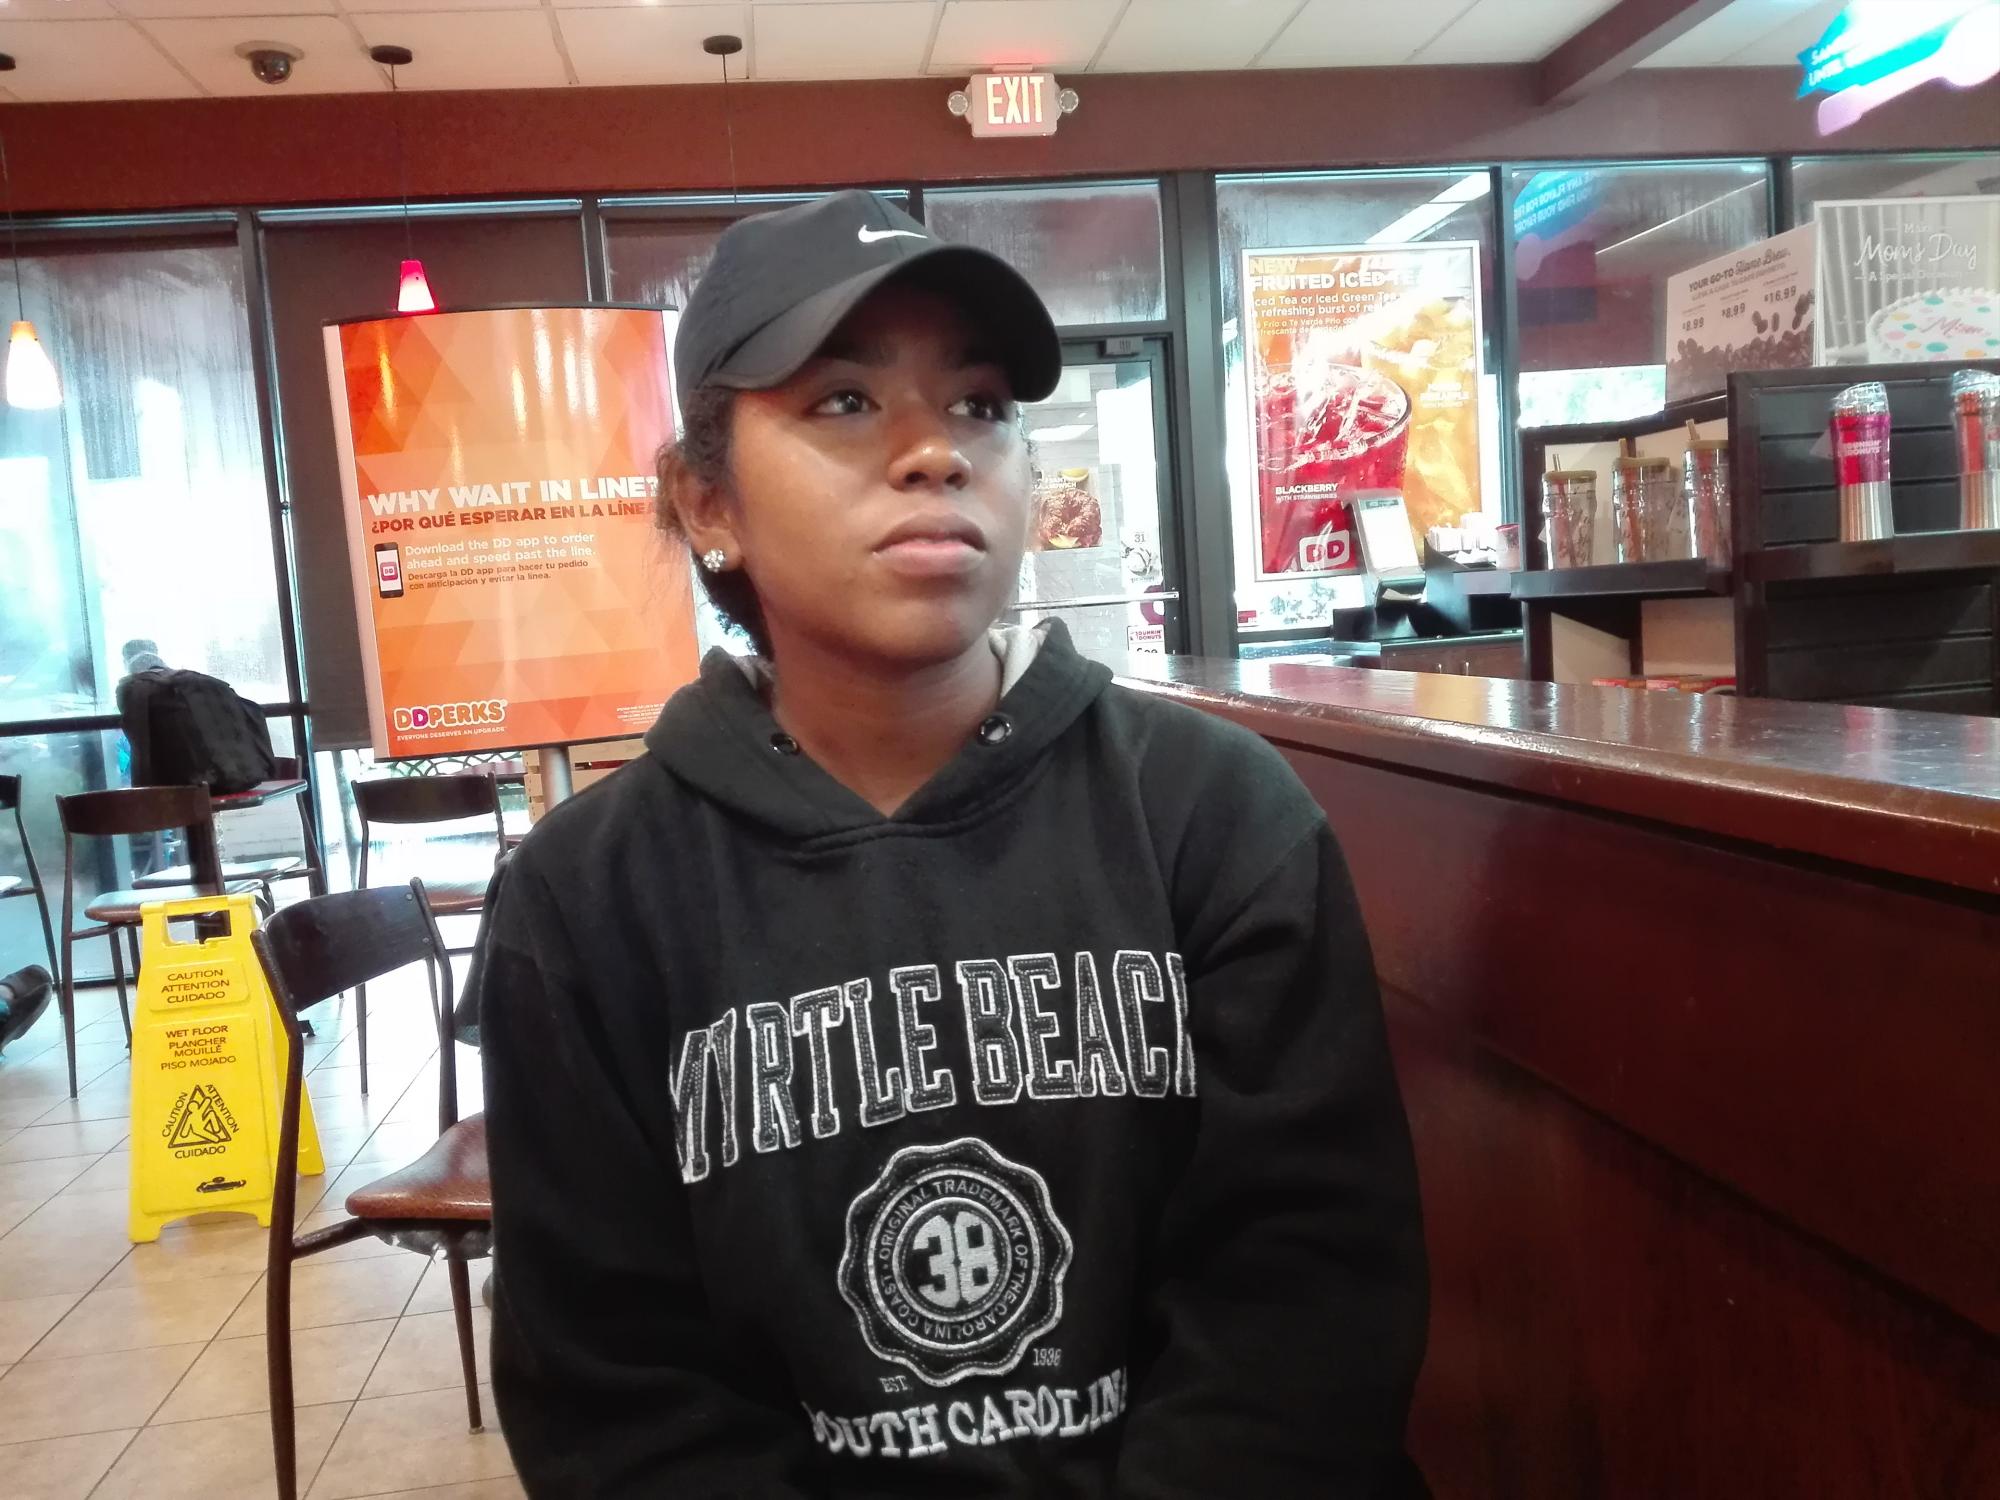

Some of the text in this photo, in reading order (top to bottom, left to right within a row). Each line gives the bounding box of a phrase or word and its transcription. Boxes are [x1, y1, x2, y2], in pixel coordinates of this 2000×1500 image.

[986, 76, 1045, 124] EXIT
[1250, 273, 1336, 292] FRUITED
[1340, 271, 1385, 289] ICED
[1689, 277, 1709, 293] YOUR
[1710, 267, 1734, 285] GO-TO
[1278, 295, 1298, 305] Tea
[1301, 295, 1313, 304] or
[1316, 293, 1339, 303] Iced
[1342, 292, 1375, 303] Green
[1261, 305, 1316, 318] refreshing
[1318, 303, 1346, 314] burst
[1349, 302, 1361, 312] of
[368, 476, 659, 517] WHY WAIT IN LINE?
[1275, 483, 1338, 495] BLACKBERRY
[371, 518, 415, 534] ¿POR
[419, 512, 457, 529] QUÉ
[460, 506, 546, 526] ESPERAR
[550, 505, 576, 520] EN
[580, 503, 604, 518] LA
[405, 531, 595, 557] Download the DD app to order
[1305, 540, 1345, 563] DD
[406, 543, 597, 570] ahead and speed past the line.
[408, 571, 447, 581] Descarga
[450, 569, 458, 577] la
[460, 568, 474, 576] DD
[477, 567, 494, 576] app
[496, 565, 516, 574] para
[558, 559, 588, 570] pedido
[397, 733, 429, 742] EVERYONE
[429, 730, 462, 739] DESERVES
[463, 728, 473, 736] AN
[161, 979, 230, 993] ATTENTION
[167, 969, 224, 982] CAUTION
[167, 991, 226, 1004] CUIDADO
[165, 1025, 229, 1038] WET FLOOR
[169, 1037, 227, 1050] PLANCHER
[174, 1044, 222, 1057] MOUILLÉ
[160, 1055, 237, 1071] PISO MOJADO
[161, 1091, 188, 1139] CAUTION
[205, 1083, 240, 1134] ATTENTION
[174, 1145, 227, 1159] CUIDADO
[879, 1179, 1029, 1341] ORIGINAL TRADEMARK OF THE CAROLINA COAST
[912, 1210, 1000, 1309] 38
[801, 1366, 1128, 1459] OUTH CAROLIN
